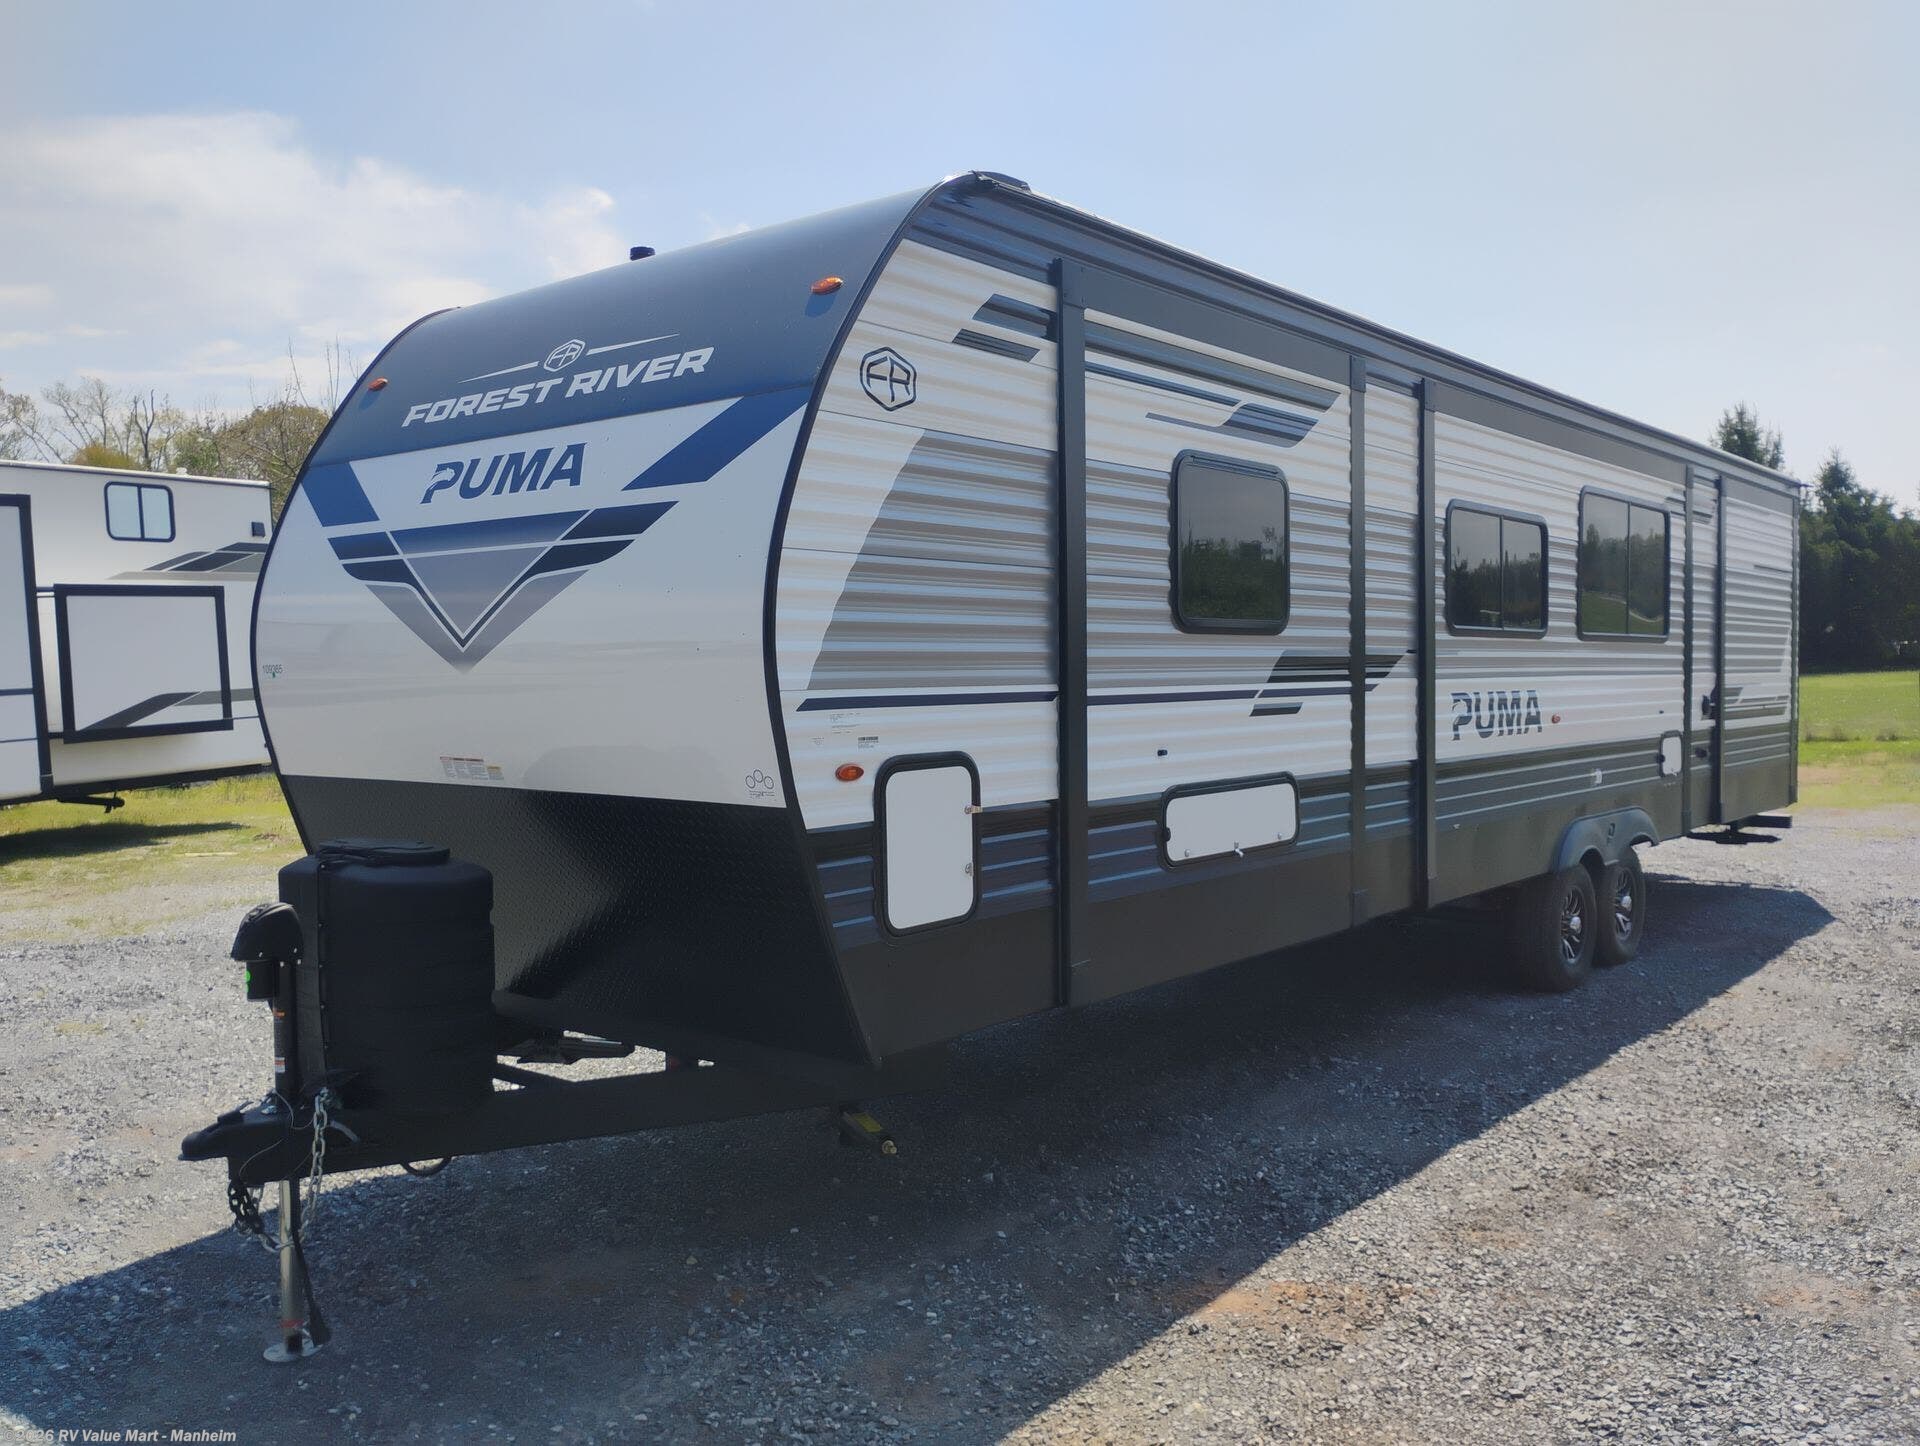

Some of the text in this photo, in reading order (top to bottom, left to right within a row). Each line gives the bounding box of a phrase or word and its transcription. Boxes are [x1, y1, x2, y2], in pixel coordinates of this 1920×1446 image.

[401, 347, 714, 427] FOREST RIVER
[420, 442, 587, 504] PUMA
[1451, 690, 1542, 741] PUMA
